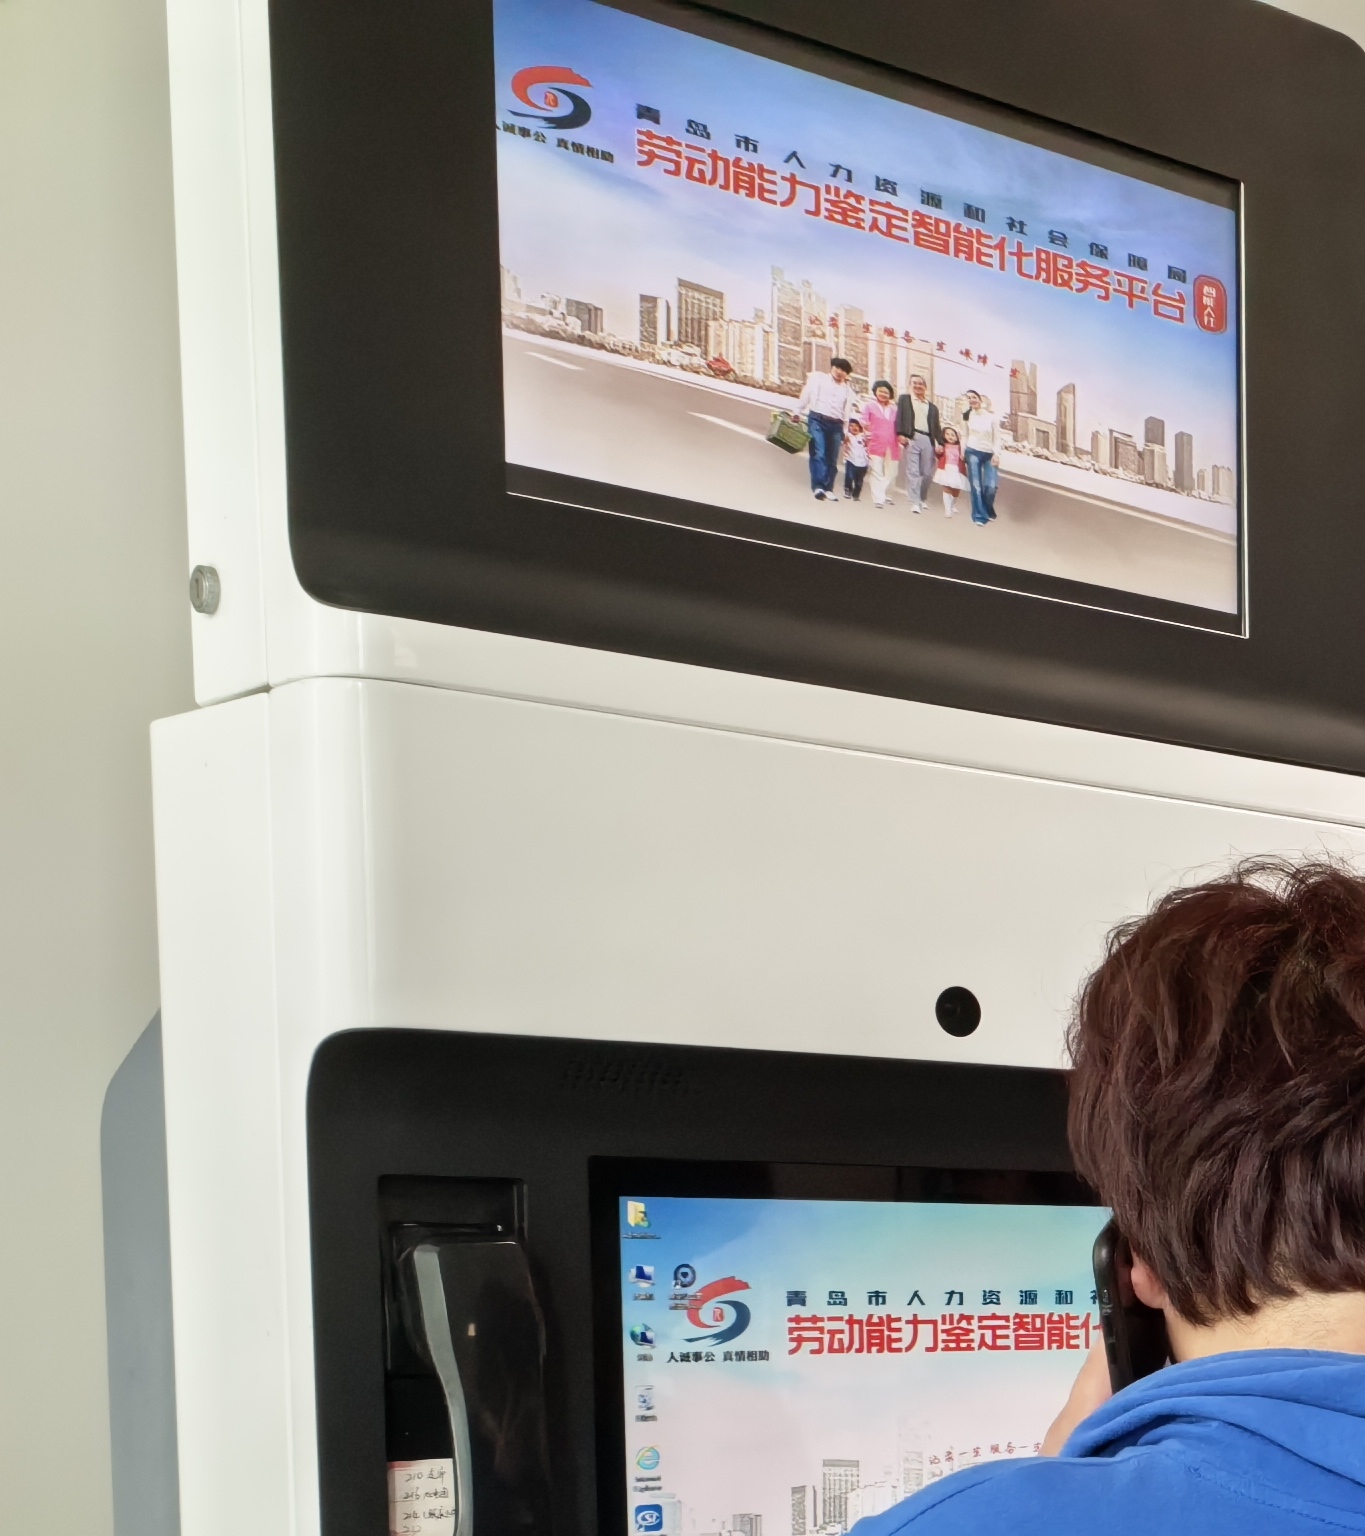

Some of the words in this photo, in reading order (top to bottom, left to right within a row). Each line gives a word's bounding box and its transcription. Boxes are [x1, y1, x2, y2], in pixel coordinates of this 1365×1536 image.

[635, 128, 1187, 324] 劳动能力鉴定智能化服务平台
[636, 103, 1187, 284] 青岛市人力资源和社会保障局
